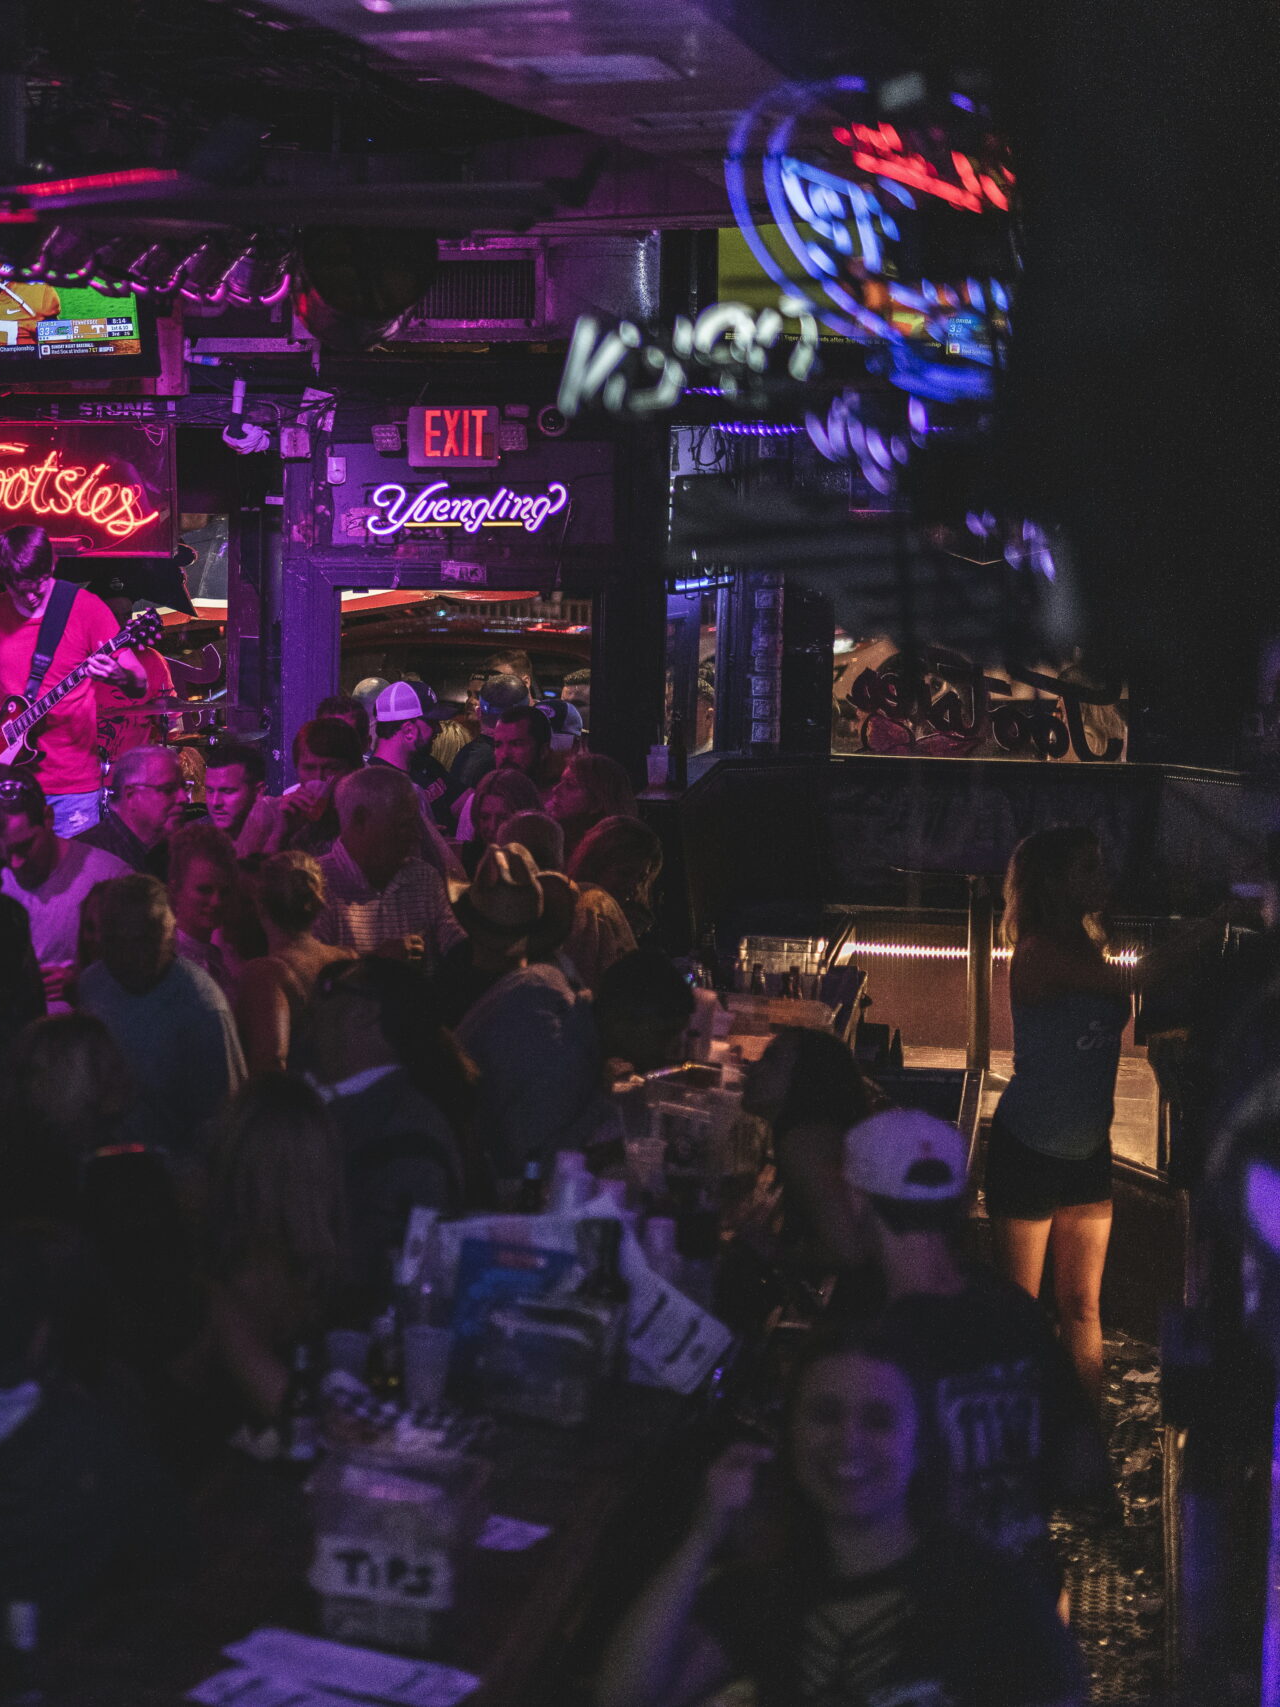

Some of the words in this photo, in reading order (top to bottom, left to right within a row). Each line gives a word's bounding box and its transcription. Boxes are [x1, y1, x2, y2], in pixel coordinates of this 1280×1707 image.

[39, 327, 51, 336] 33
[73, 325, 80, 335] 6
[0, 344, 35, 354] Championship
[424, 409, 488, 457] EXIT
[366, 480, 569, 536] Yuengling
[333, 1550, 433, 1595] TIPS
